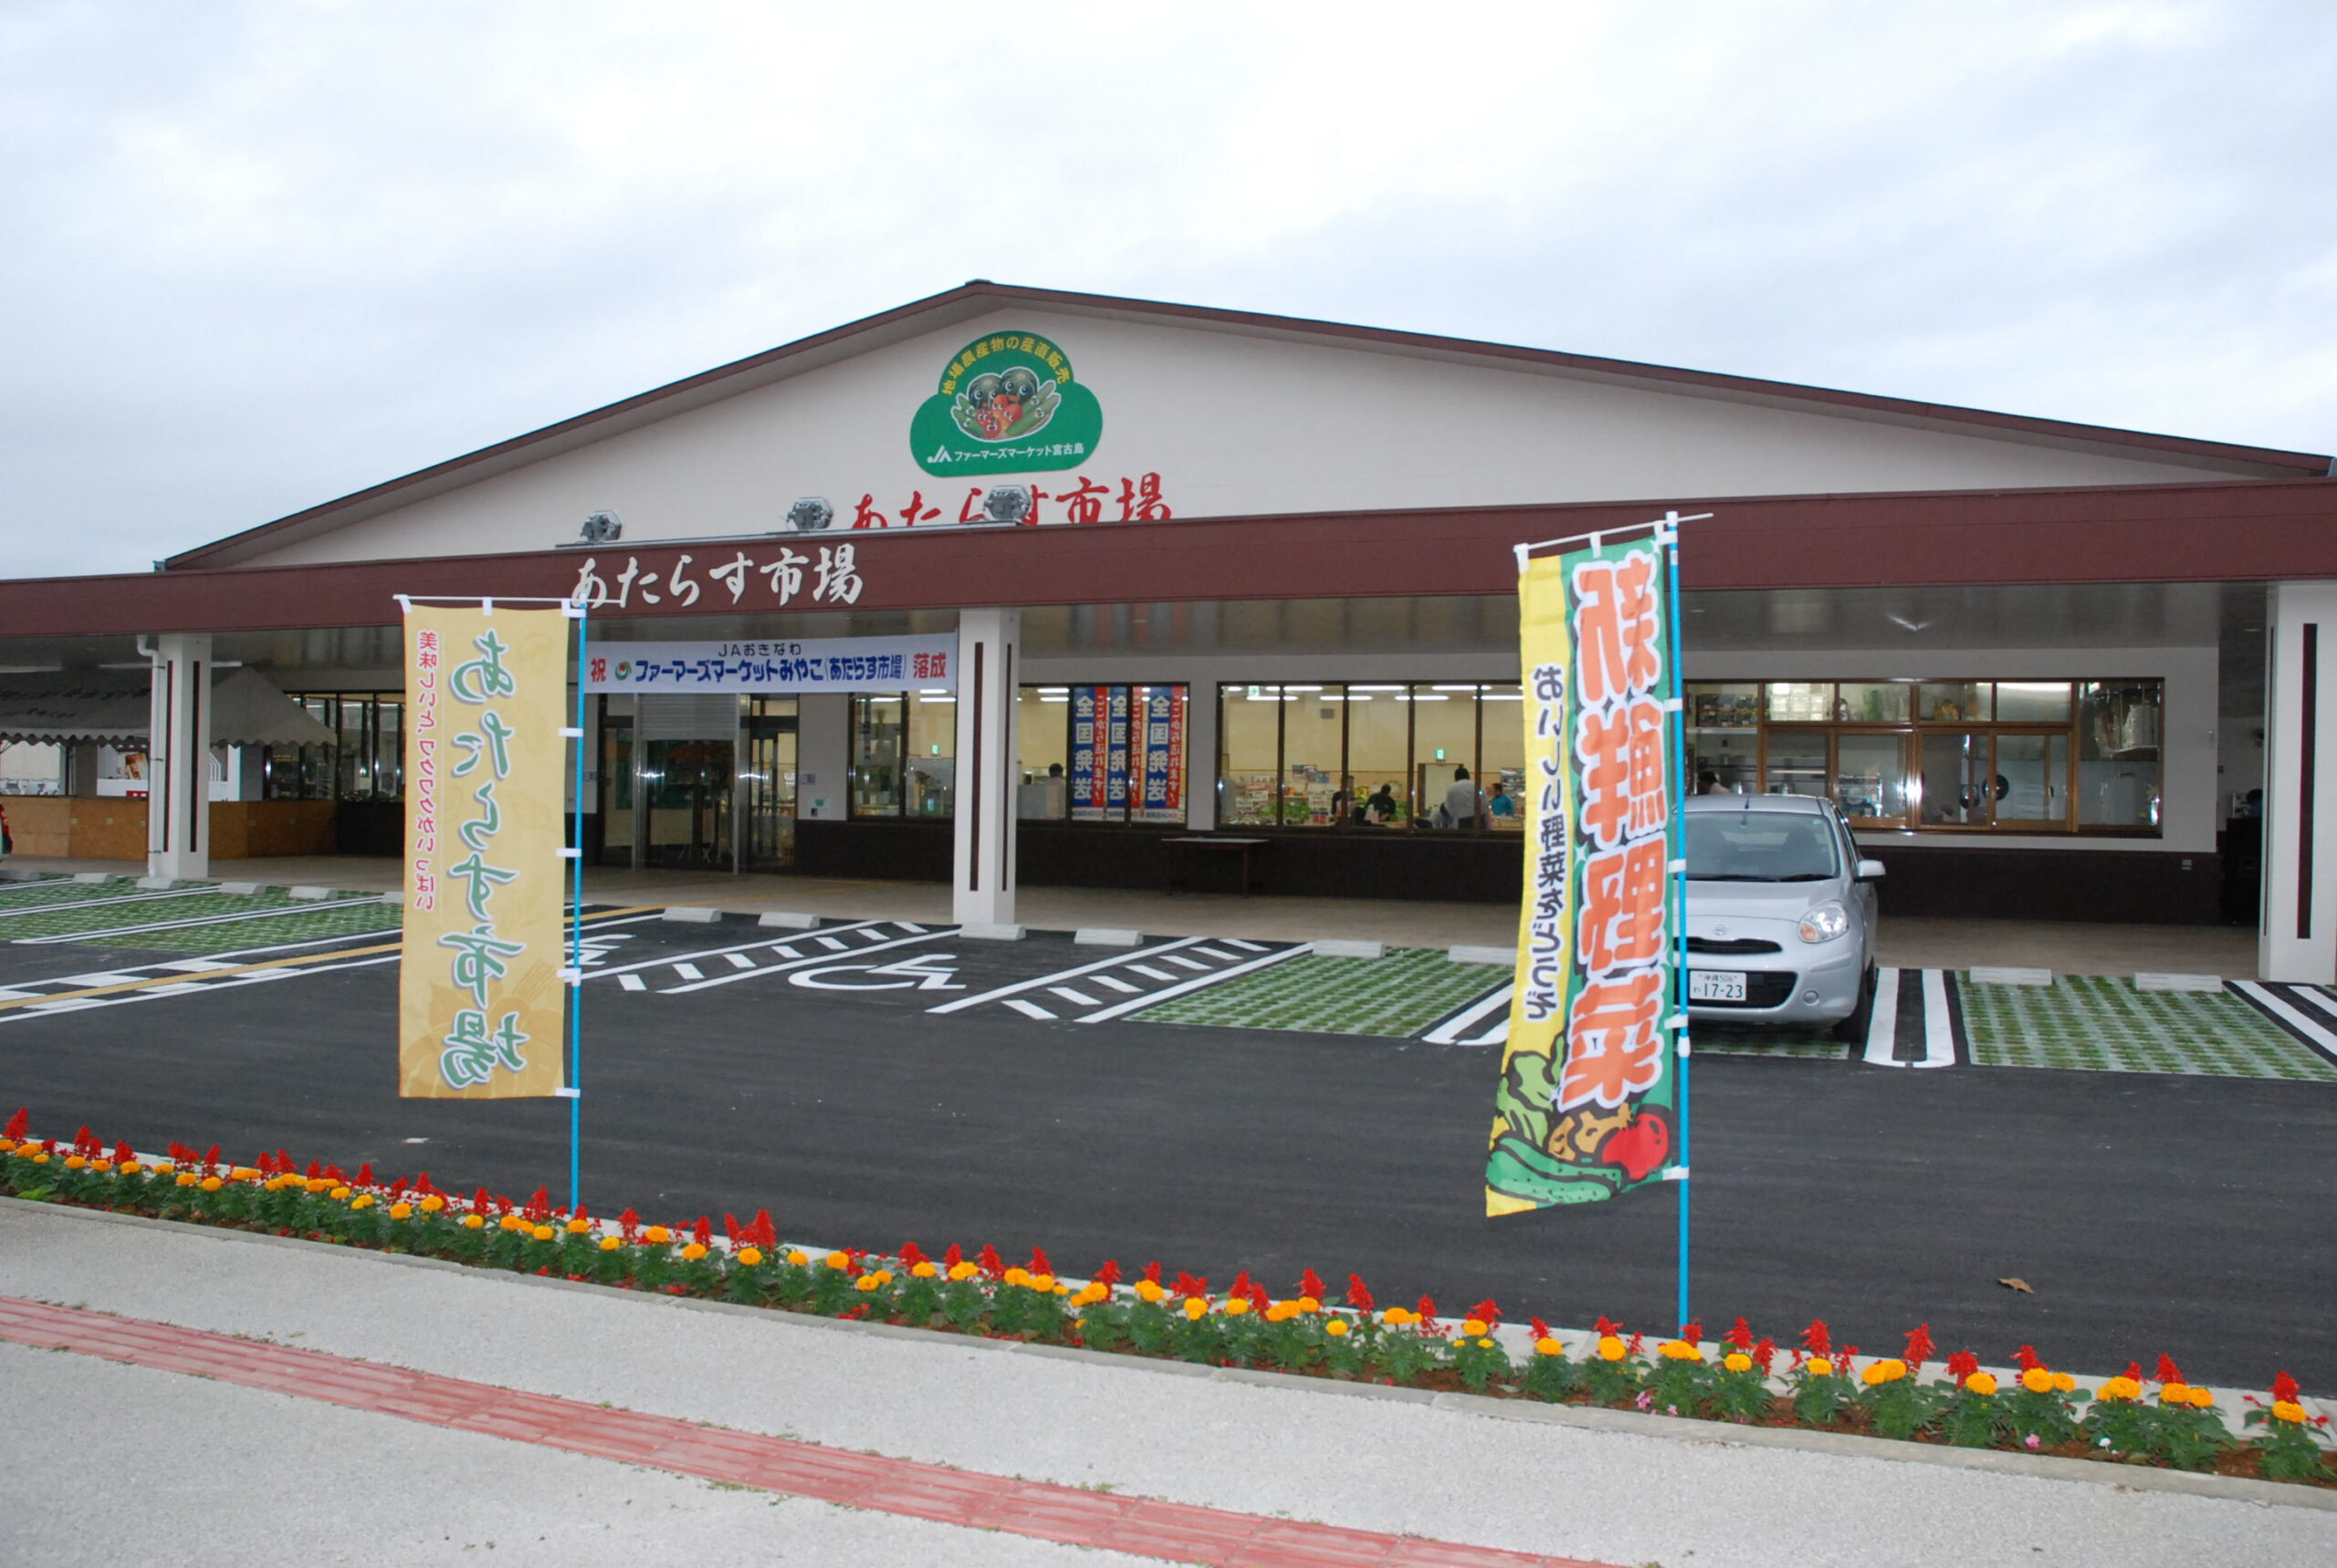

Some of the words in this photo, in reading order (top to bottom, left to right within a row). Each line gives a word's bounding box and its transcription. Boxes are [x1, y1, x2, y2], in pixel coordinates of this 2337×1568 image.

[571, 542, 864, 610] あたらす市場
[718, 643, 802, 657] JAおきなわ
[590, 657, 607, 683] 祝
[913, 652, 948, 680] 落成
[1703, 983, 1743, 998] 17-23
